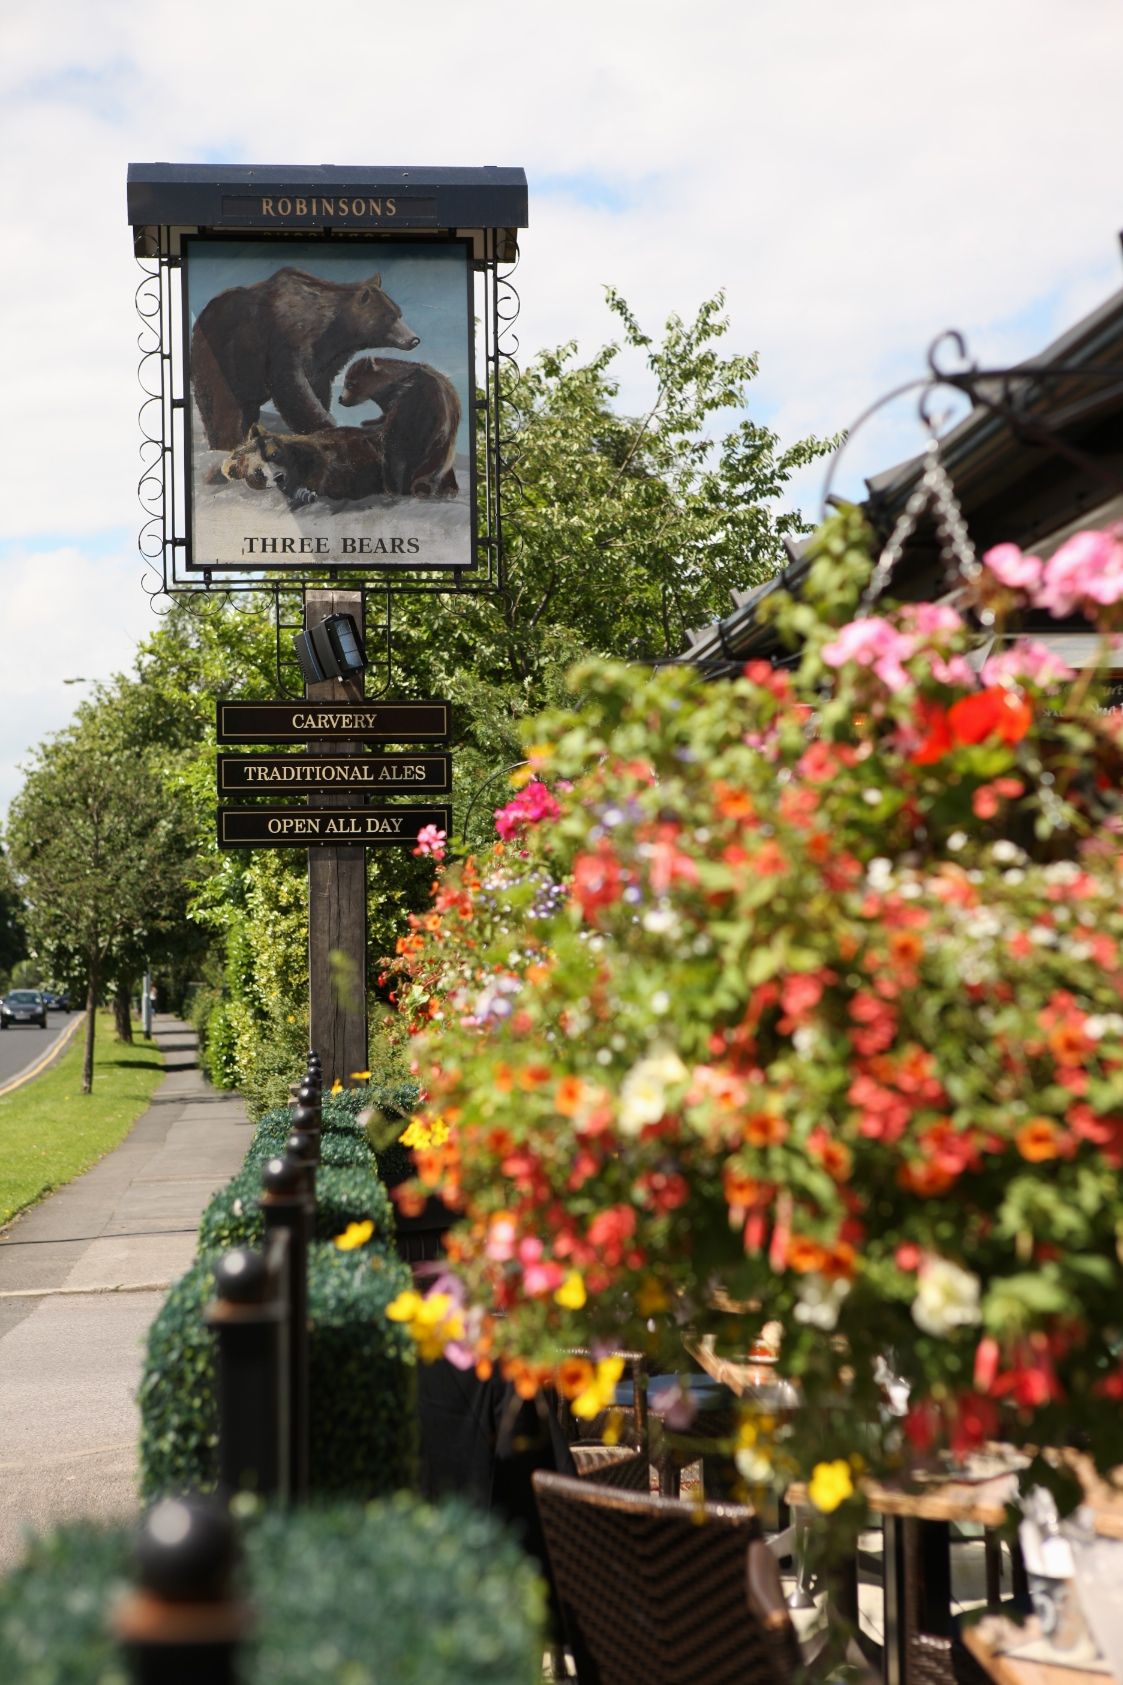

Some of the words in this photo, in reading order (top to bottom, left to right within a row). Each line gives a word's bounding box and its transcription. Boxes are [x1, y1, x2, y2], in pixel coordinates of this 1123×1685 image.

[262, 198, 397, 216] ROBINSONS
[244, 537, 330, 554] THREE
[341, 537, 420, 554] BEARS
[292, 713, 377, 729] CARVERY
[244, 765, 374, 781] TRADITIONAL
[378, 765, 426, 780] ALES
[267, 818, 321, 834] OPEN
[325, 818, 362, 833] ALL
[366, 818, 403, 833] DAY
